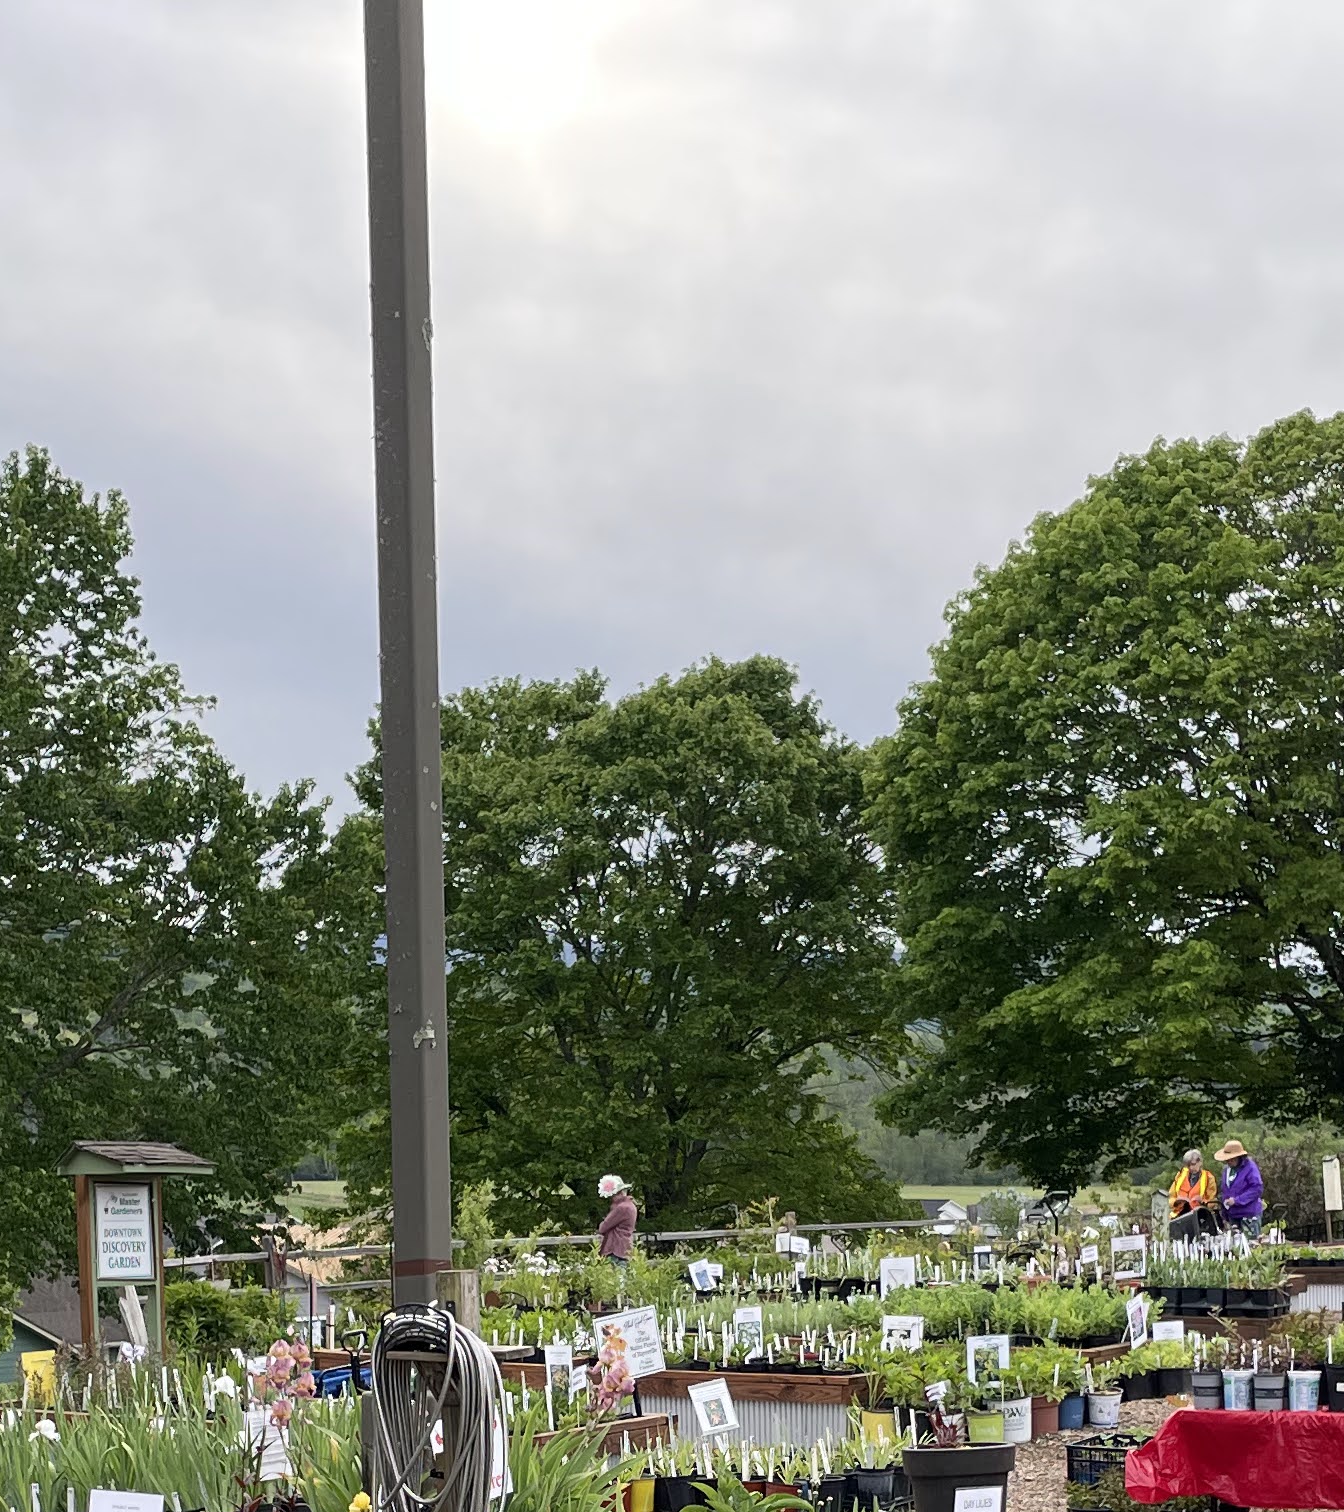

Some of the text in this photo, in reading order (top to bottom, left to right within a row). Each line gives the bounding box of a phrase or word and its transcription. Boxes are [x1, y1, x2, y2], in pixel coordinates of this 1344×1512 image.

[119, 1197, 141, 1206] Master
[110, 1206, 143, 1216] Gardeners
[103, 1228, 143, 1238] DOWNTOWN
[102, 1241, 147, 1254] DISCOVERY
[108, 1256, 141, 1269] GARDEN
